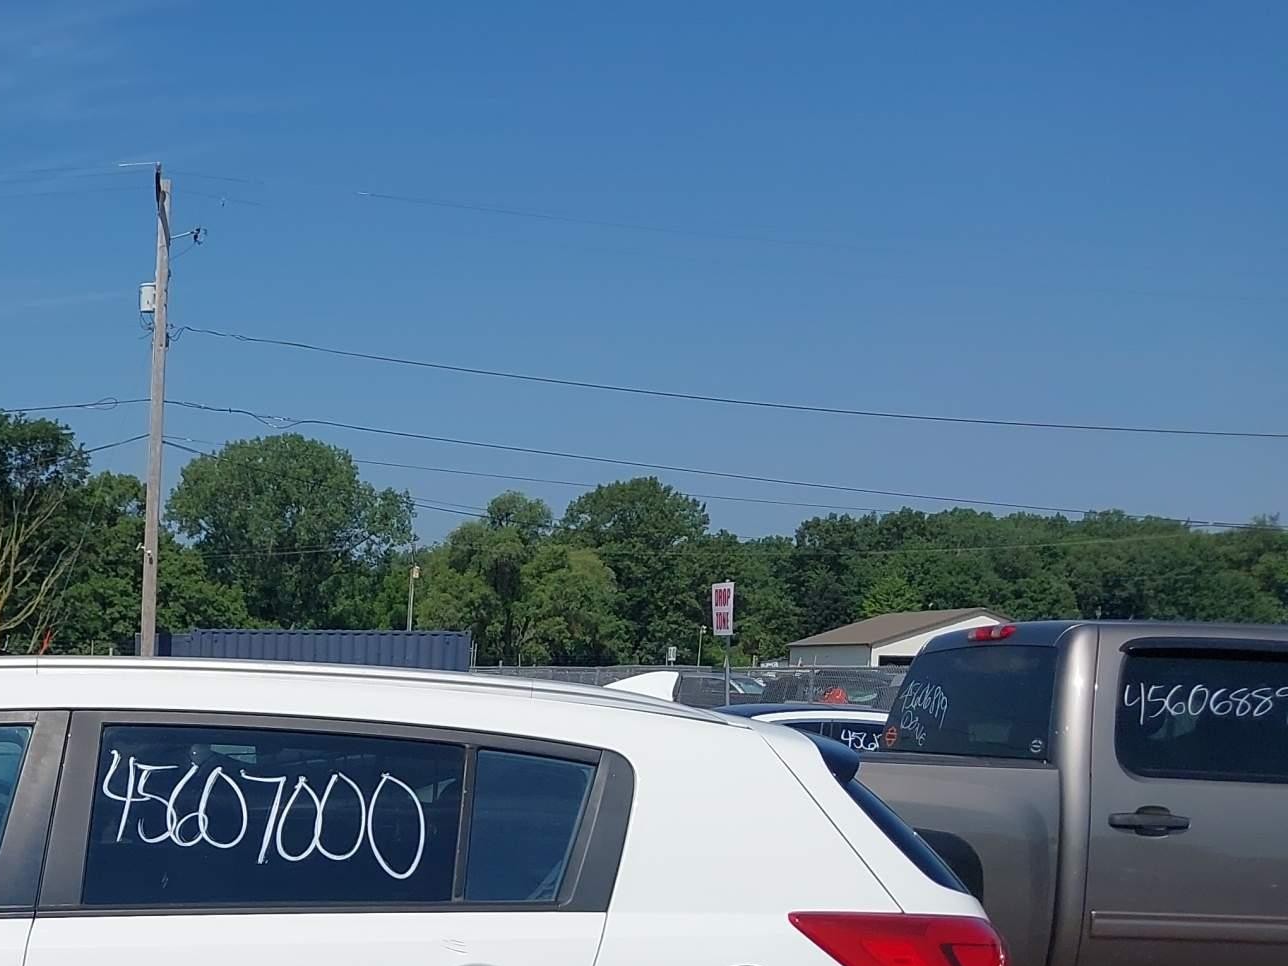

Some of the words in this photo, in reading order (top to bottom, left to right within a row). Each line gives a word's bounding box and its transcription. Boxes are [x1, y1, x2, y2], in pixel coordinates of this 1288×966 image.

[714, 587, 731, 607] DROP
[715, 611, 730, 630] ZONE
[102, 749, 426, 880] 45607000
